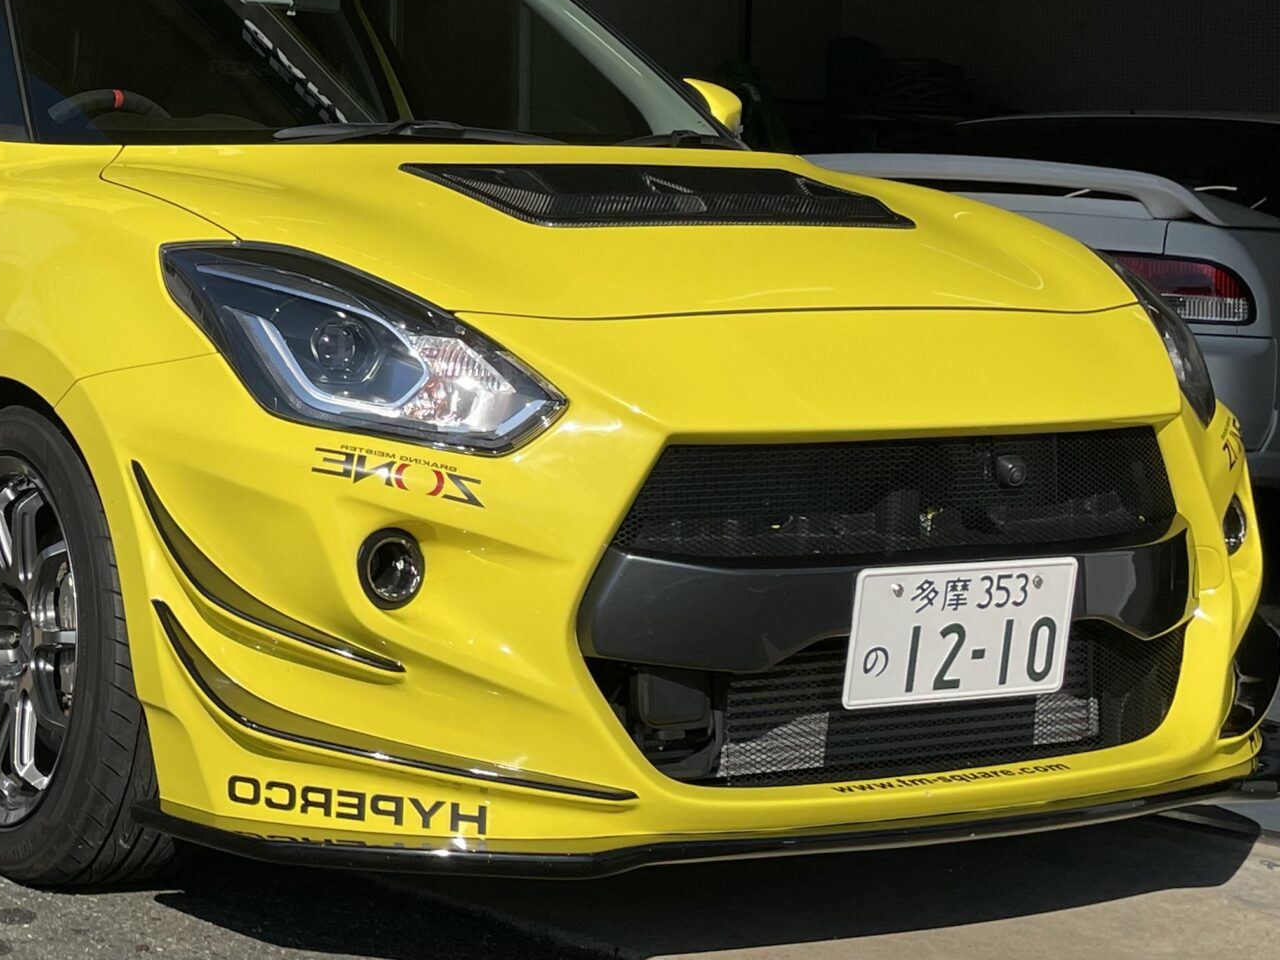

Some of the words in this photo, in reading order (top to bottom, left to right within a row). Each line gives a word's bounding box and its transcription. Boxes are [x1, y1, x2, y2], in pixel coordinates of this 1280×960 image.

[910, 577, 973, 614] 多摩
[975, 573, 1030, 611] 353
[862, 646, 890, 678] の
[904, 616, 1058, 693] 12-10
[831, 761, 1072, 794] www.tm-square.com
